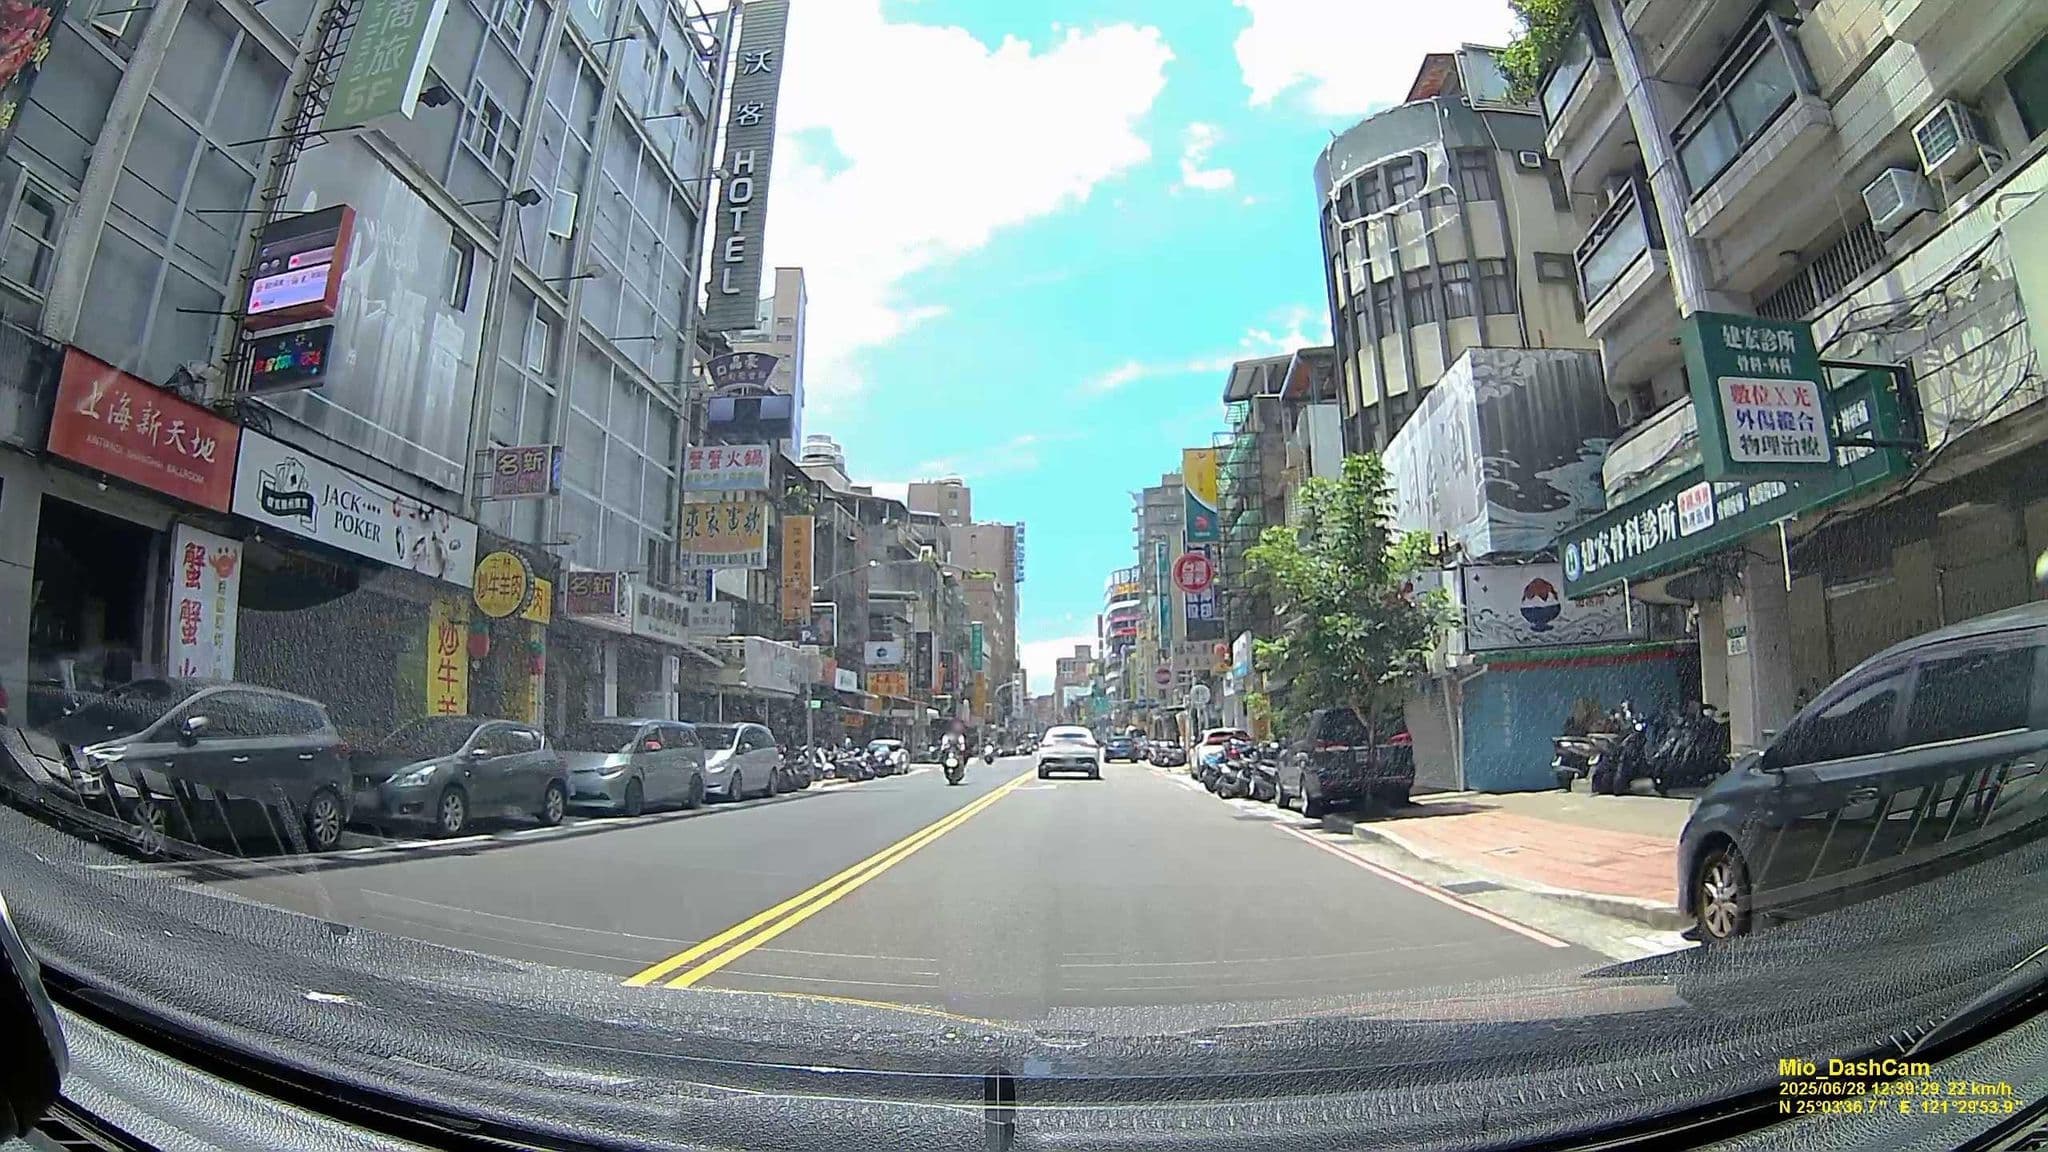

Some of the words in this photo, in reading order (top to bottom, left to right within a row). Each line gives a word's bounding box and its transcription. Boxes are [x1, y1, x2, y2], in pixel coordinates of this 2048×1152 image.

[344, 78, 393, 115] 5F
[735, 49, 772, 128] 沃客
[721, 150, 755, 295] HOTEL
[79, 379, 216, 464] 上海新天地
[322, 484, 359, 514] JACK
[334, 510, 381, 544] POKER
[1581, 499, 1678, 573] 建宏骨科診所
